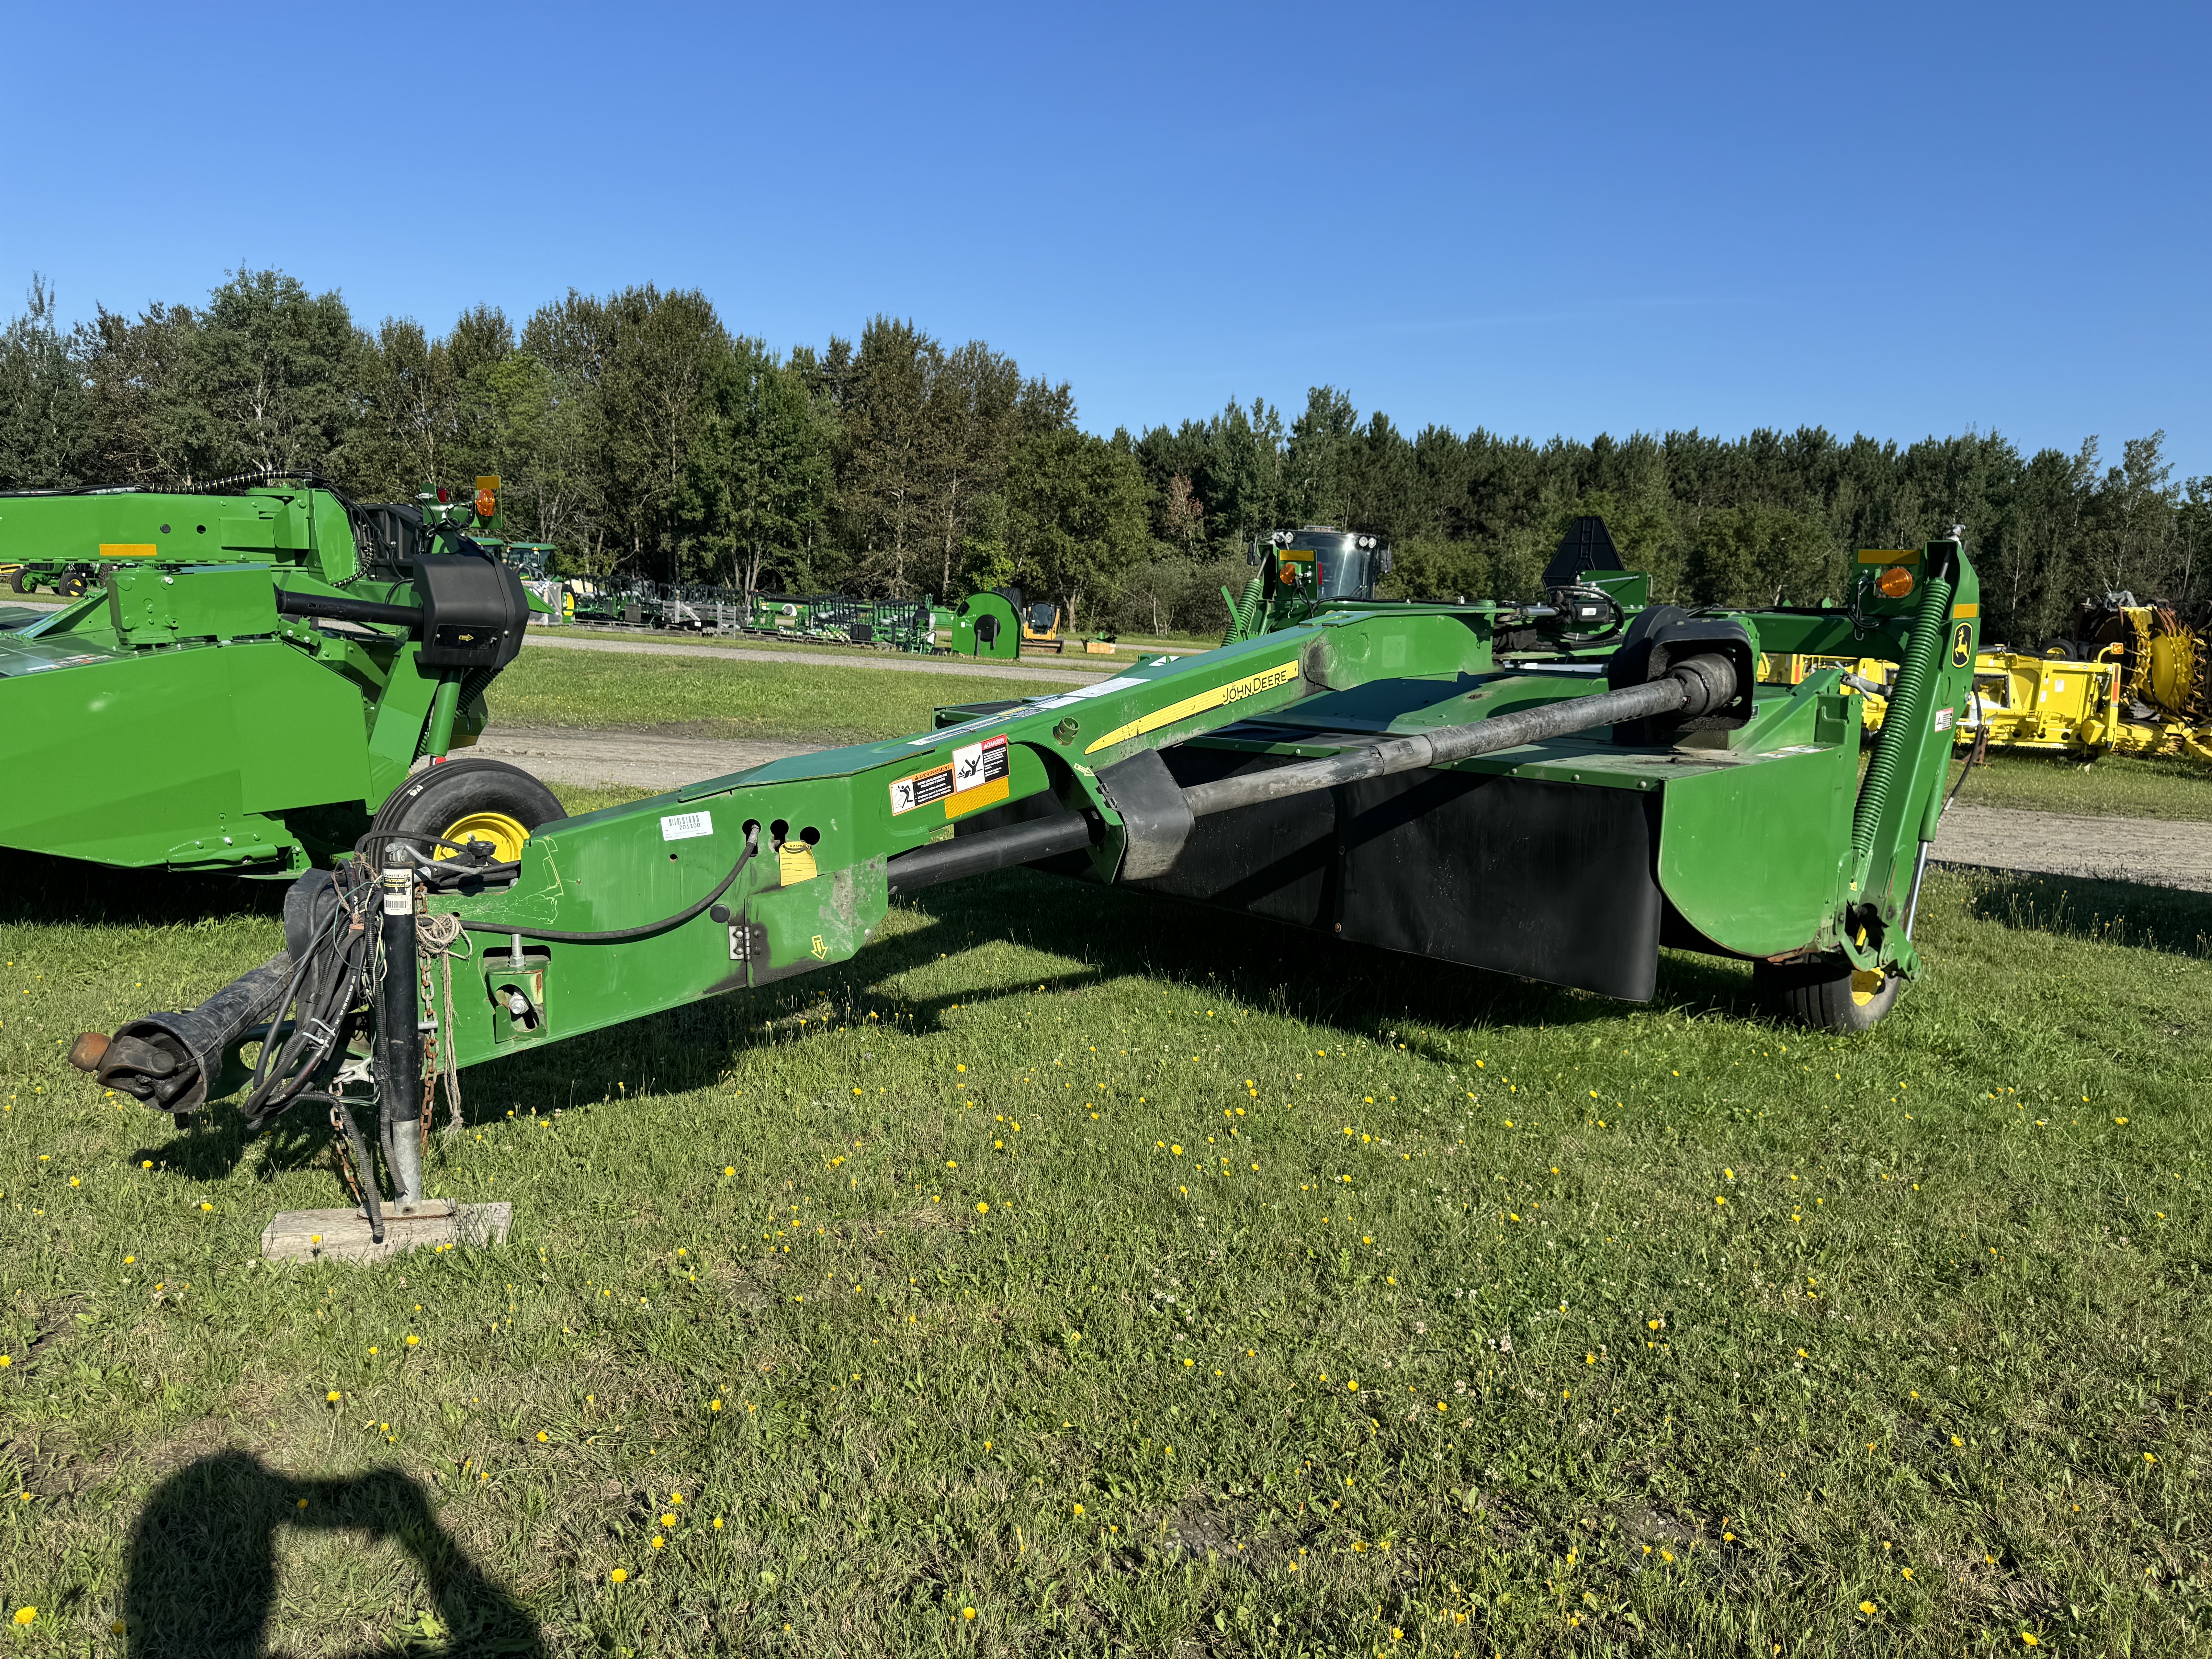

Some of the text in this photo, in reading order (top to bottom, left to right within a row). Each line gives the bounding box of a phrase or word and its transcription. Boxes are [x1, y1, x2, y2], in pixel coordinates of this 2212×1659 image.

[1223, 670, 1286, 703] JOHN DEERE
[987, 737, 1005, 748] DANGER
[919, 765, 950, 779] AVERTISSEMENT
